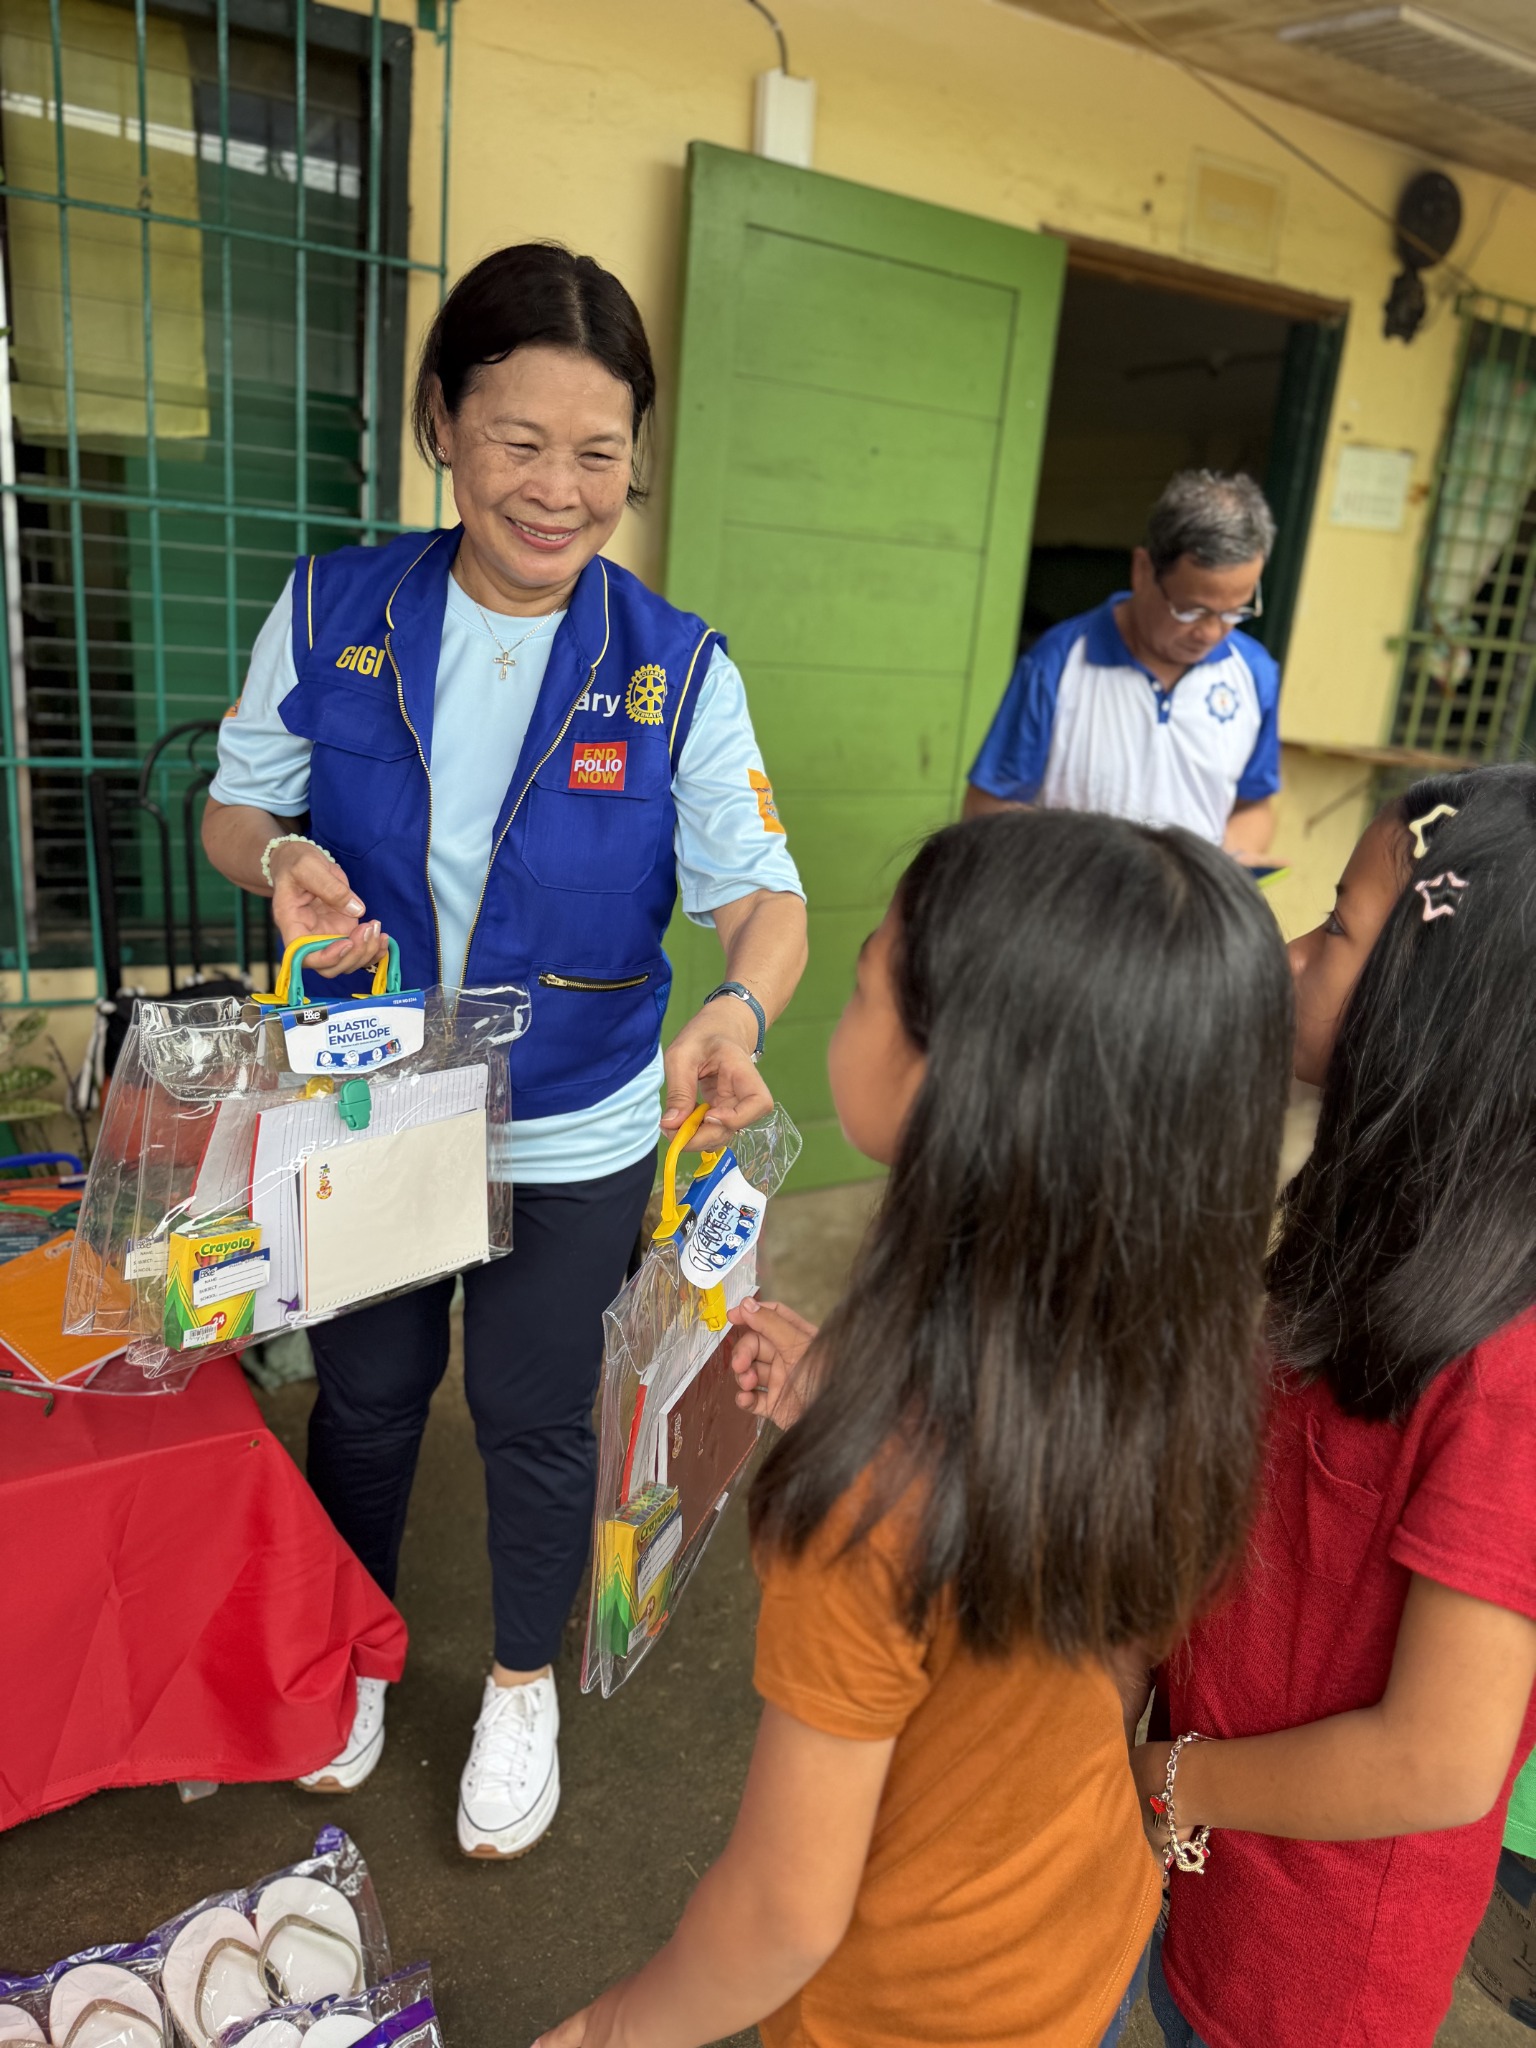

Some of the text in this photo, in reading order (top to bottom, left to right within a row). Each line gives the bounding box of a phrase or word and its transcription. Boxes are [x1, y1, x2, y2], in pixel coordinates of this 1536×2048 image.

[335, 645, 386, 678] GIGI
[583, 748, 617, 760] END
[574, 759, 622, 772] POLIO
[577, 771, 617, 784] NOW
[328, 1017, 378, 1034] PLASTIC
[328, 1026, 391, 1046] ENVELOPE
[200, 1237, 251, 1255] Crayola
[212, 1313, 225, 1326] 24
